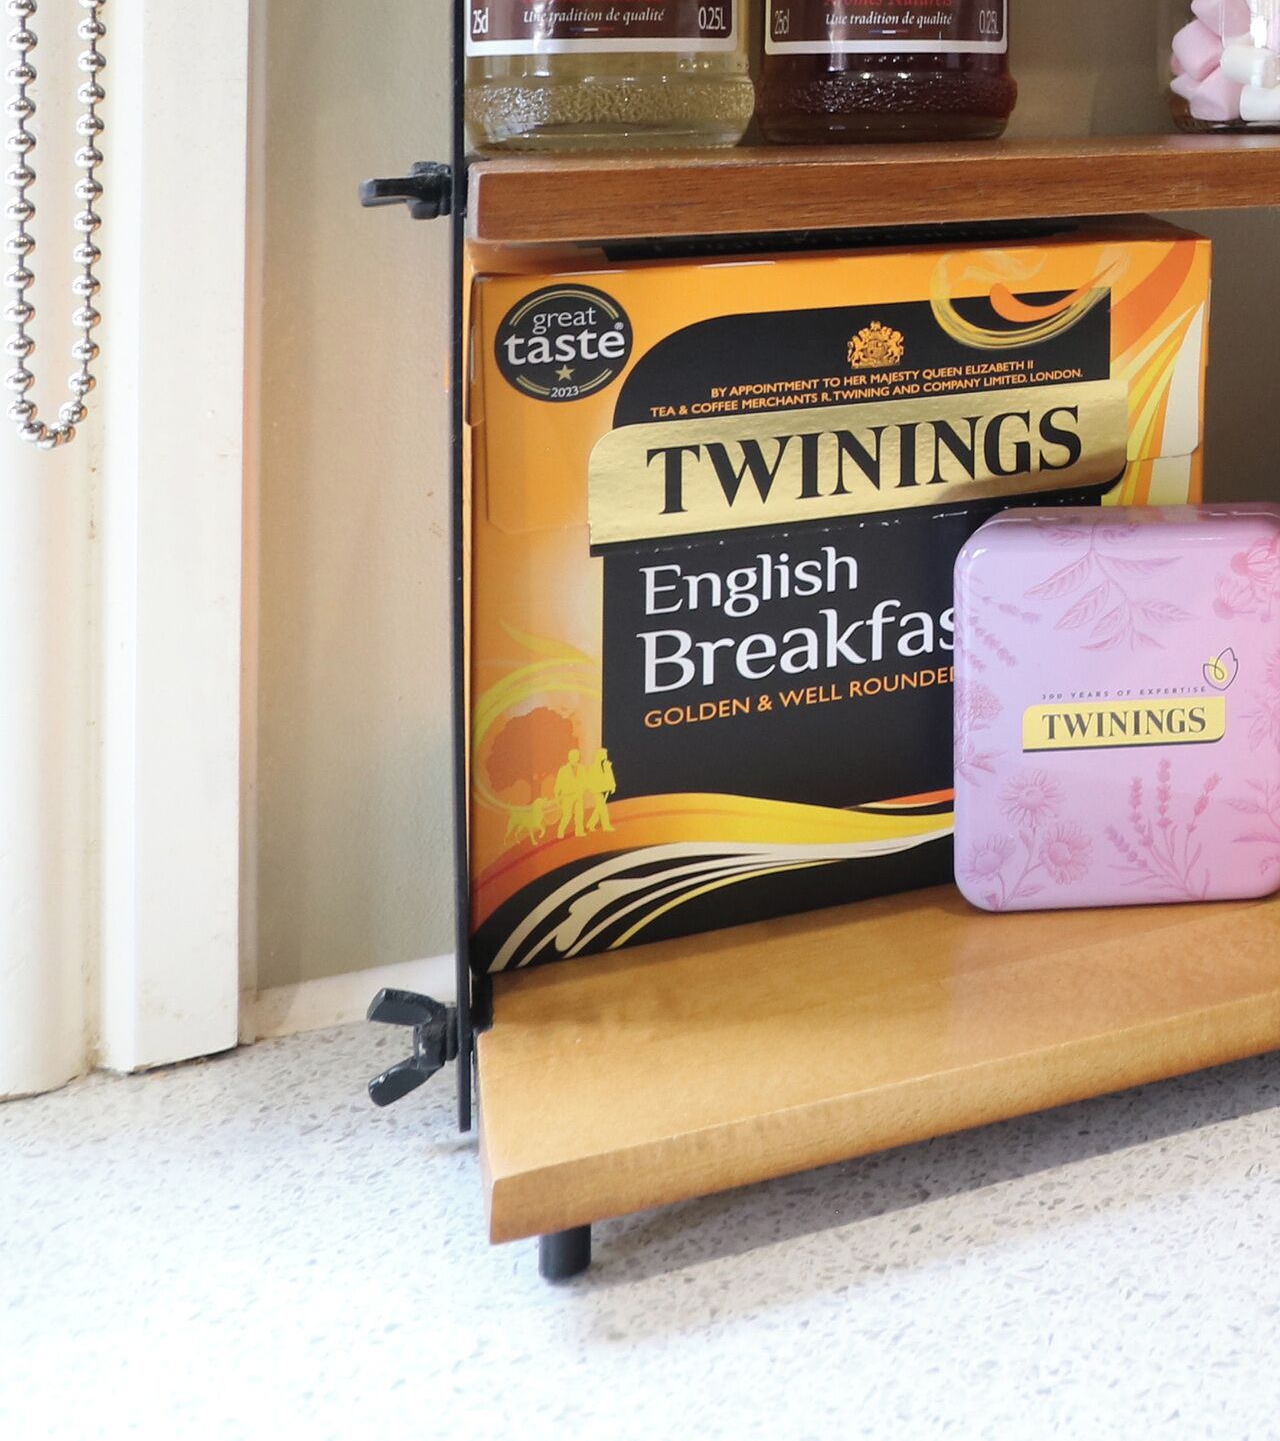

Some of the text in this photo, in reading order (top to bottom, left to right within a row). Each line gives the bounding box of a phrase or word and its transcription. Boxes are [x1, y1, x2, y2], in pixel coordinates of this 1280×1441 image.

[606, 7, 620, 21] de
[622, 8, 664, 25] qualité
[698, 6, 727, 30] 0.25L
[825, 11, 953, 28] Une tradition de qualité
[532, 307, 597, 335] great
[503, 329, 625, 365] taste
[550, 386, 579, 398] 2023
[650, 405, 676, 418] TEA
[678, 405, 688, 416] &
[691, 400, 739, 414] COFFEE
[741, 392, 818, 409] MERCHANTS
[821, 392, 832, 402] R.
[833, 387, 889, 402] TWINING
[893, 384, 920, 396] AND
[923, 378, 981, 393] COMPANY
[1030, 369, 1083, 382] LONDON.
[711, 387, 727, 398] BY
[729, 379, 820, 397] APPOINTMENT
[823, 377, 840, 388] TO
[844, 375, 866, 386] HER
[870, 370, 920, 385] MAJESTY
[922, 366, 963, 380] QUEEN
[965, 360, 1026, 375] ELIZABETH
[646, 405, 1083, 516] TWININGS
[638, 546, 858, 617] English
[636, 599, 955, 694] Breakfas
[644, 666, 955, 728] GOLDEN & WELL ROUNDE
[1071, 690, 1109, 699] YEARS
[1140, 686, 1206, 696] EXPERTISE
[1042, 707, 1207, 740] TWININGS
